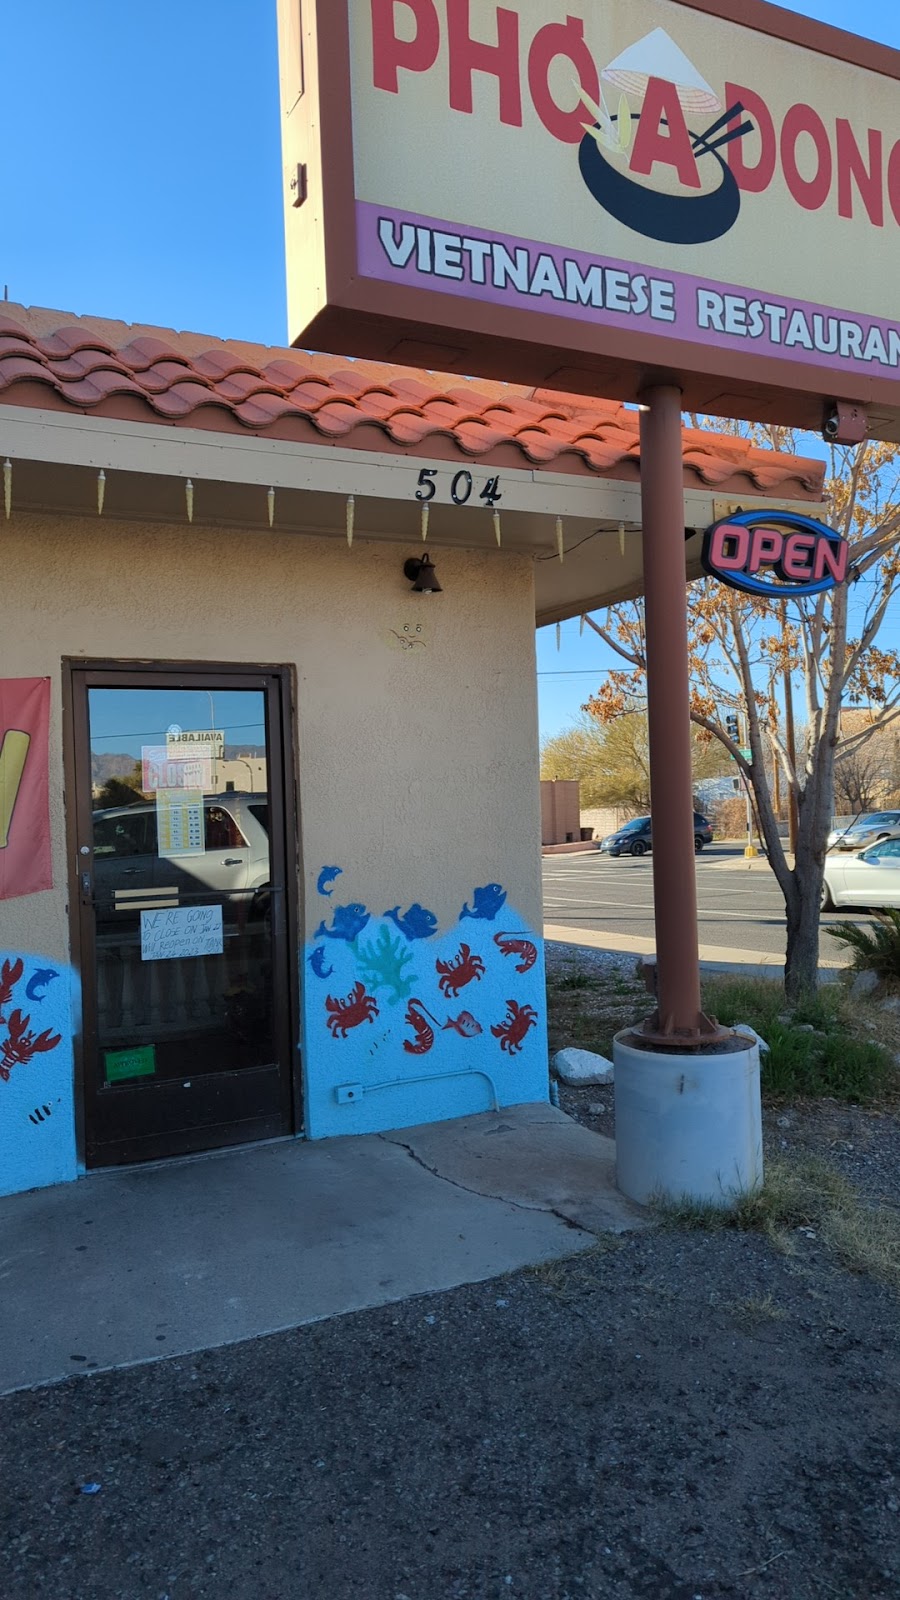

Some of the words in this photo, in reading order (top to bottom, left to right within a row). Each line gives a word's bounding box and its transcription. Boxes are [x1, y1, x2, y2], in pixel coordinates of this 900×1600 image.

[629, 76, 701, 189] A
[377, 216, 676, 322] VIETNAMESE
[415, 468, 502, 507] 504
[709, 523, 849, 584] OPEN
[143, 910, 183, 929] WE'RE
[154, 927, 180, 942] CLOSE
[184, 925, 198, 935] ON
